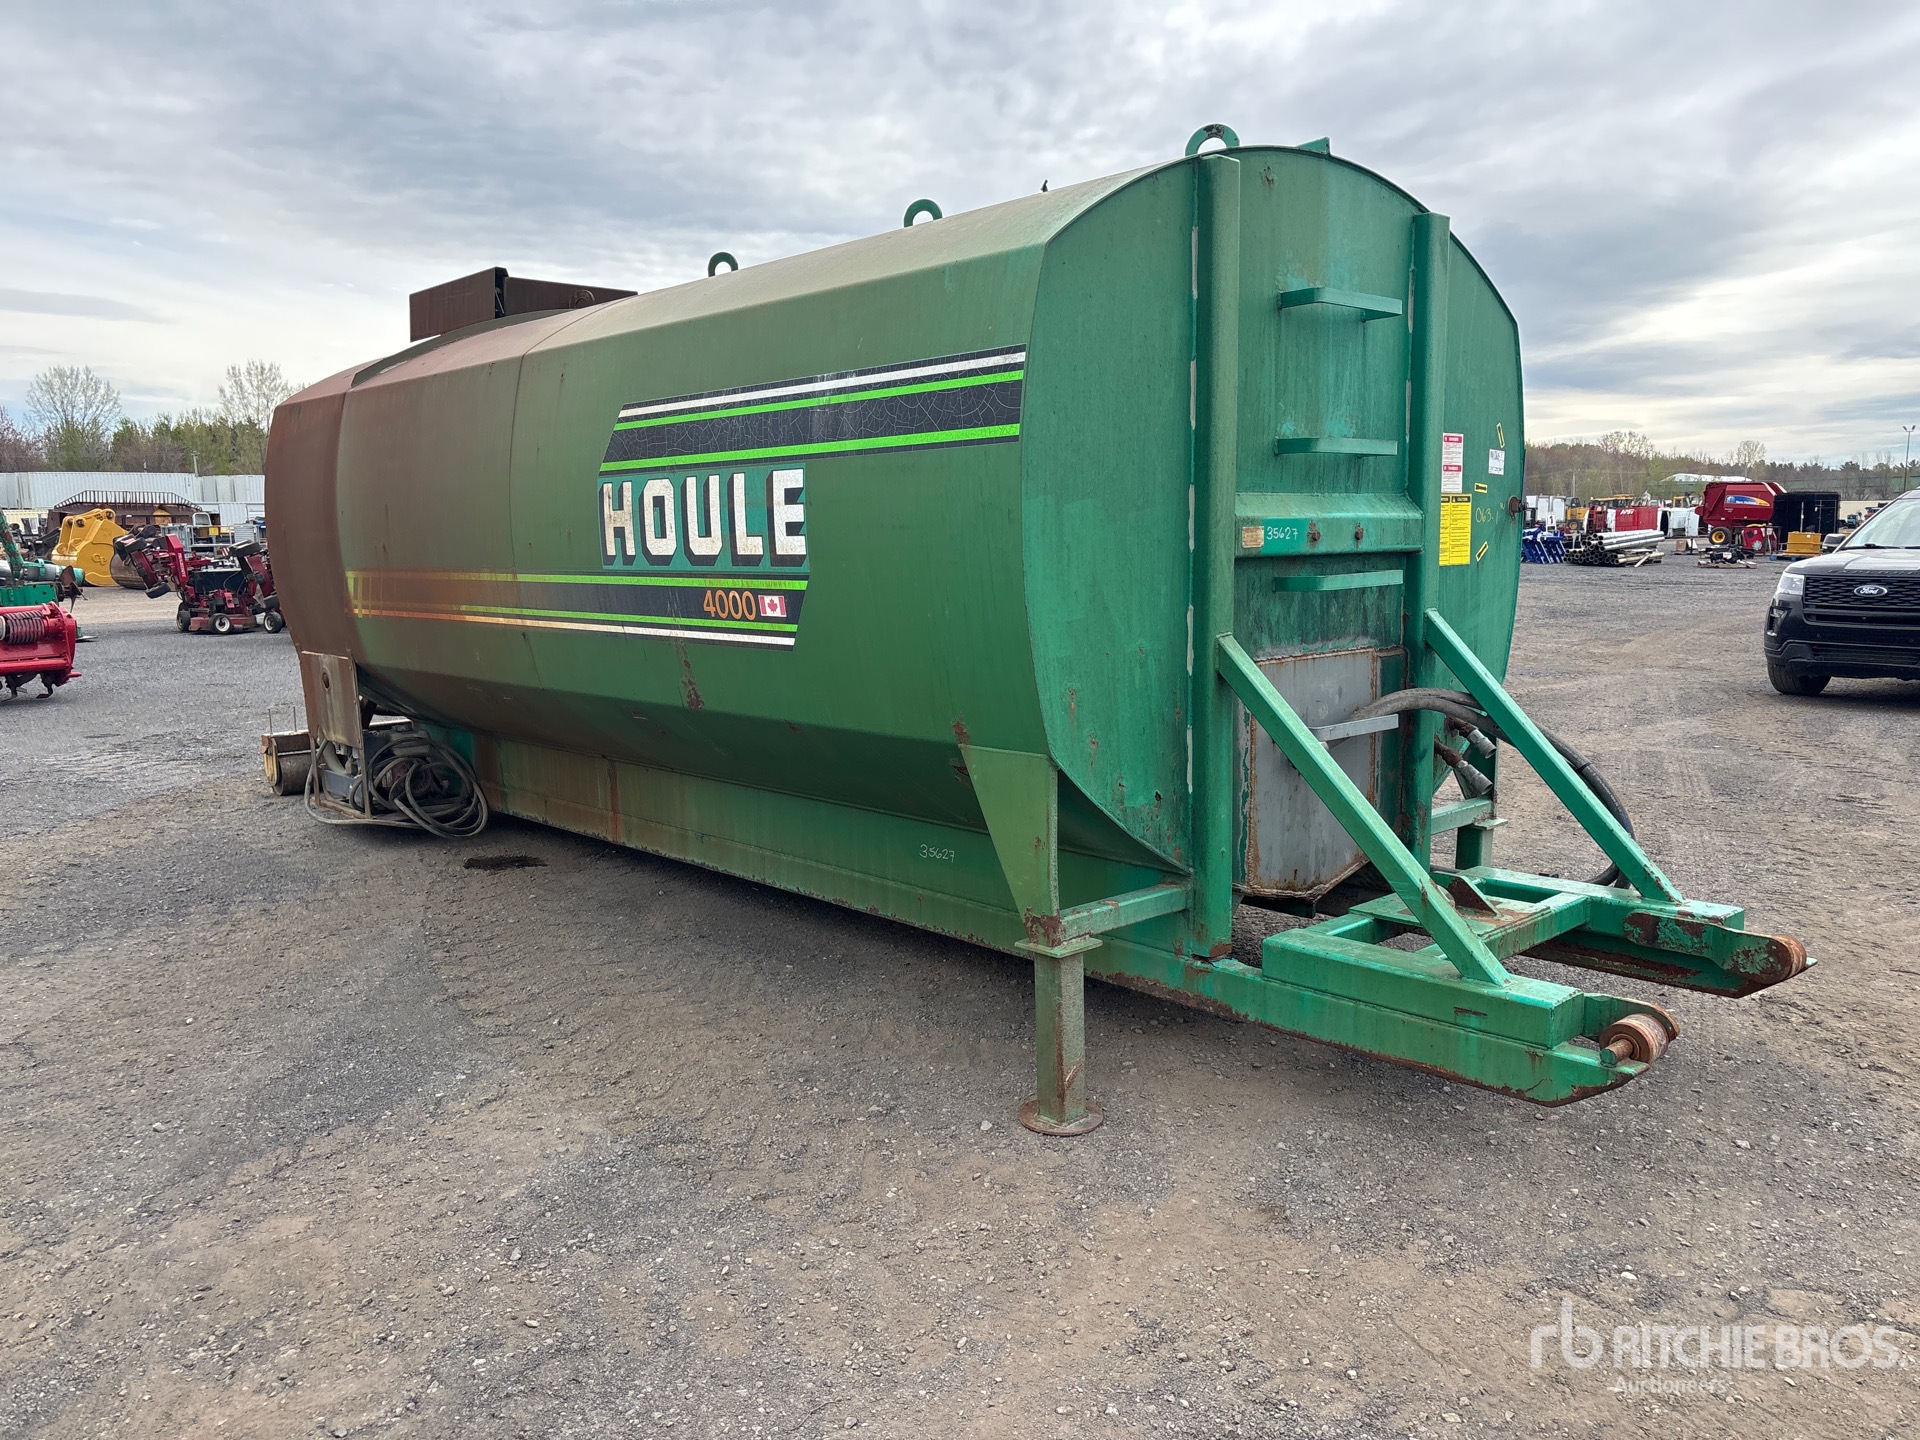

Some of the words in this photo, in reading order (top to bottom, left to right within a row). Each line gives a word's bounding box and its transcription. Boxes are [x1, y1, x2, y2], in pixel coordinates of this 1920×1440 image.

[599, 468, 807, 566] HOULE
[1266, 526, 1299, 540] 35627
[703, 589, 757, 621] 4000
[919, 843, 955, 863] 35627
